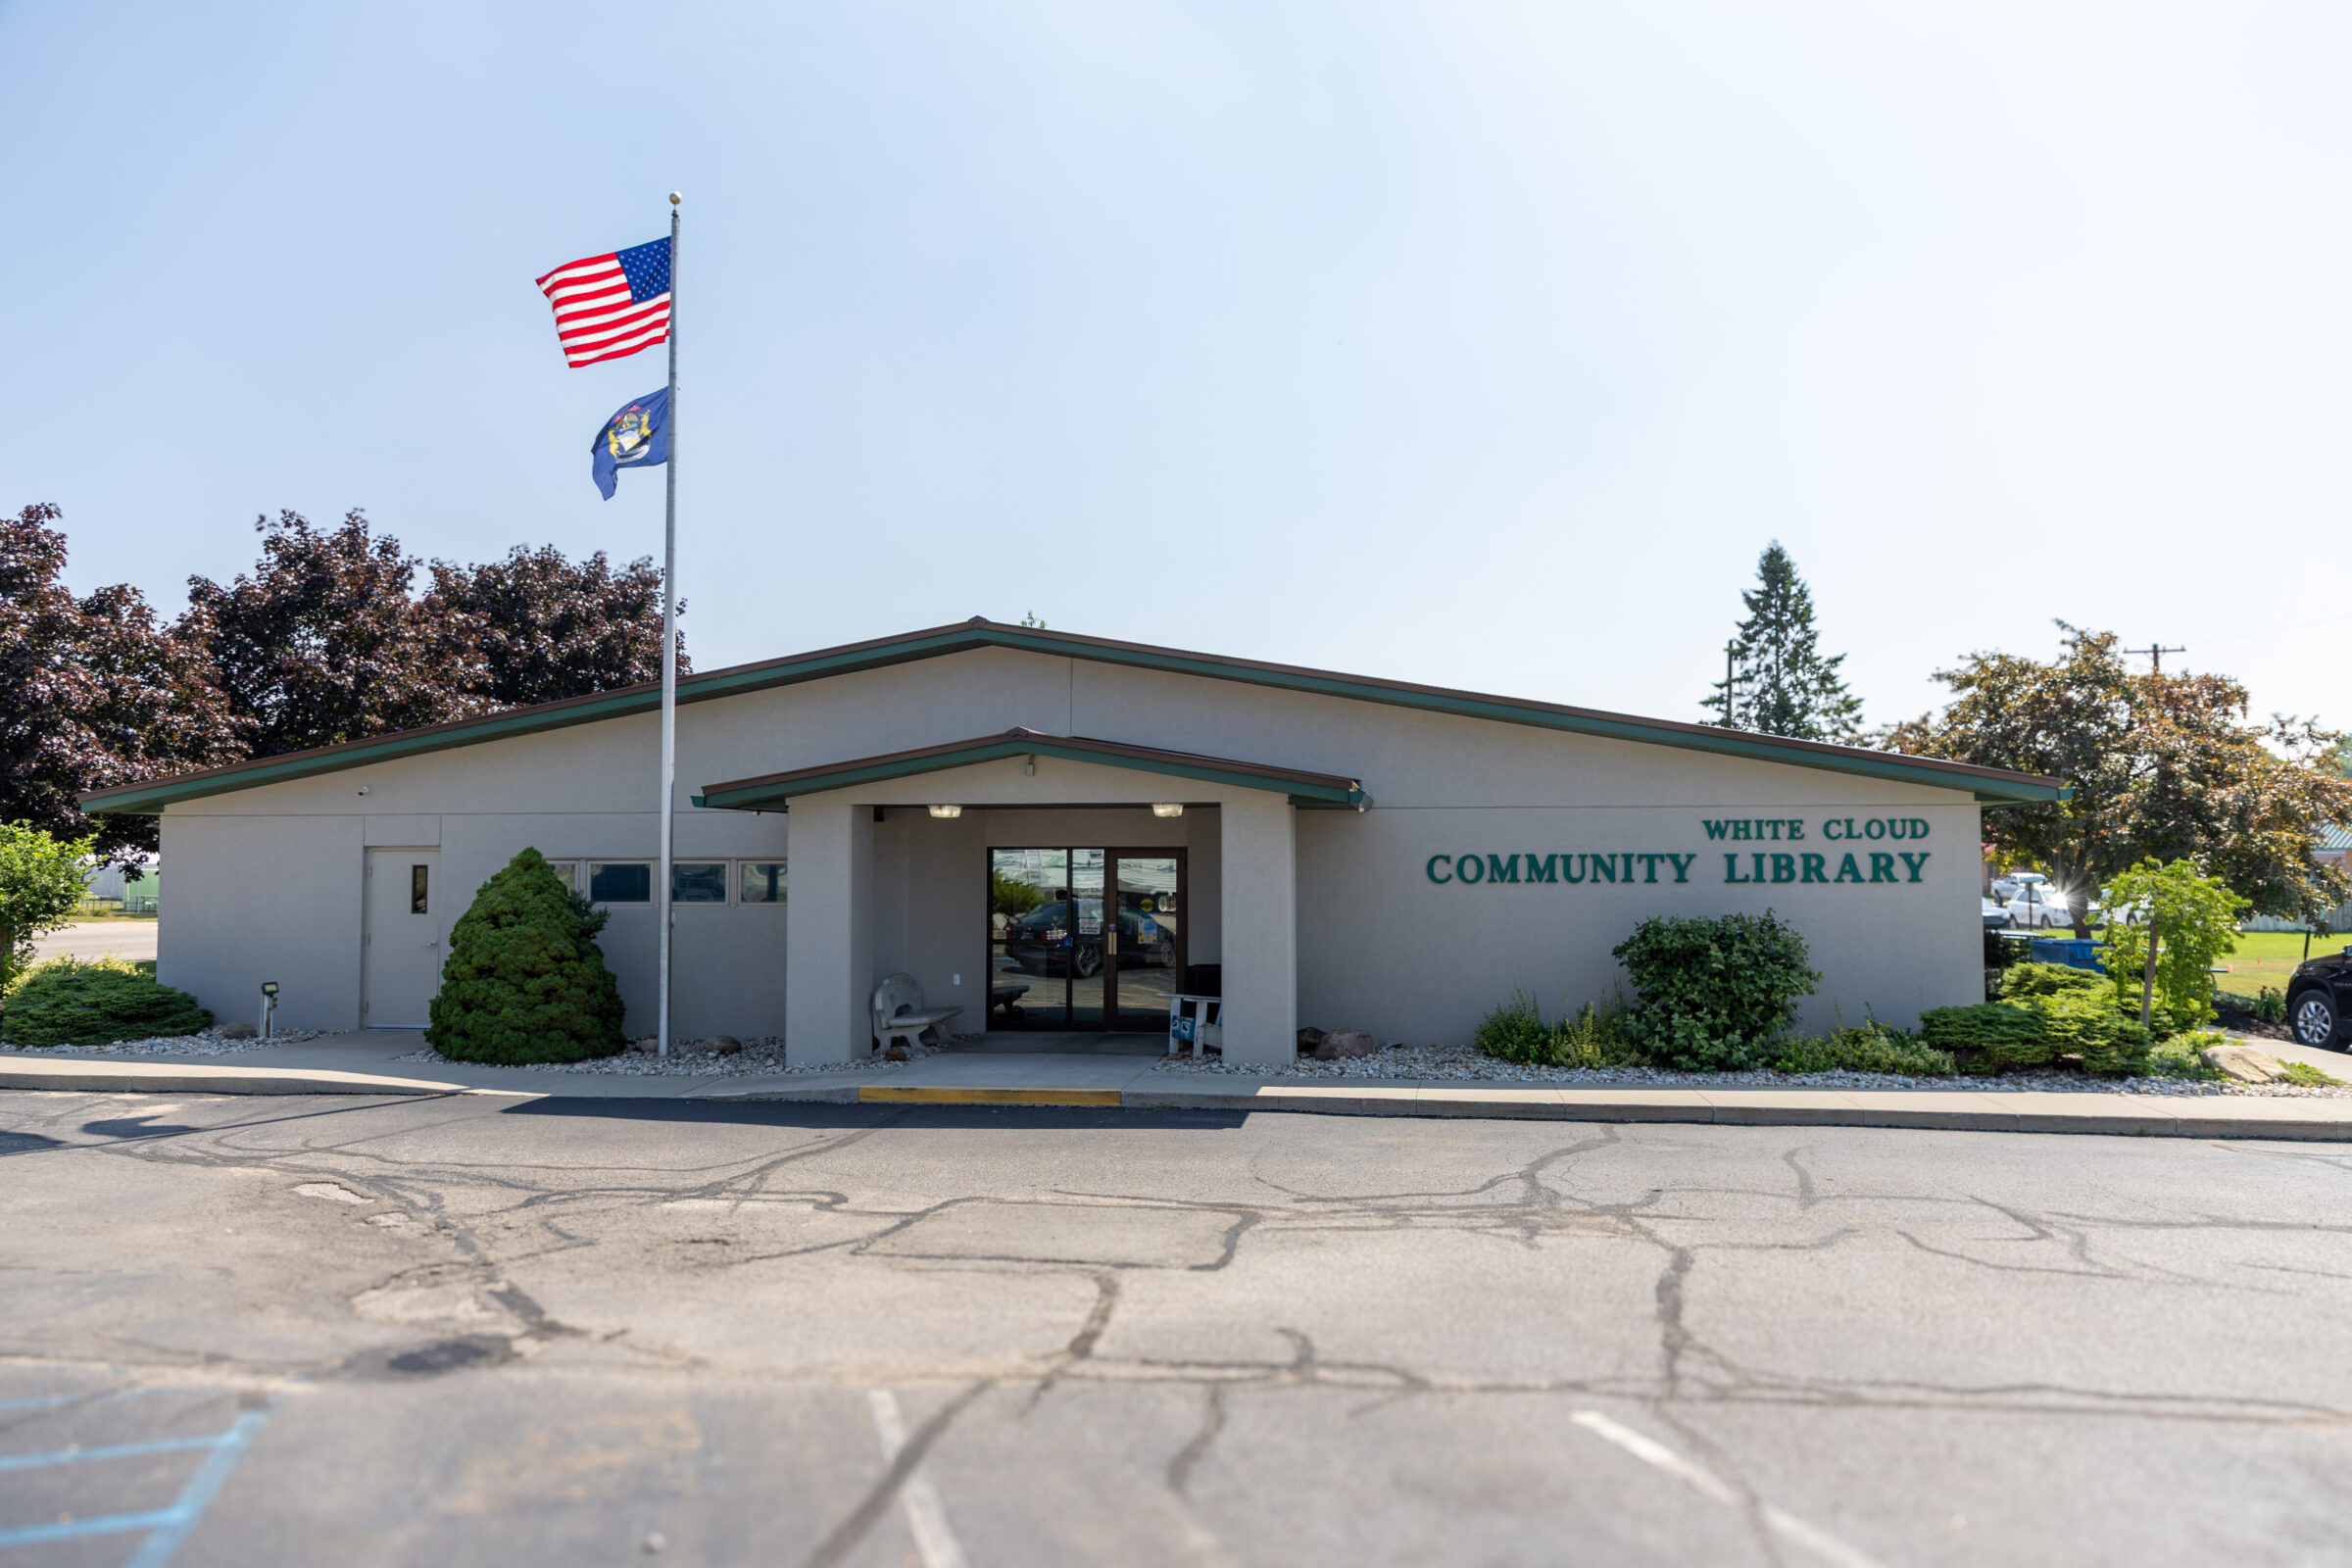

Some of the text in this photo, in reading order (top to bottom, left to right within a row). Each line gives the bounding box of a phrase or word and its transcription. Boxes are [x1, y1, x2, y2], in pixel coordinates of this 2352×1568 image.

[1702, 818, 1930, 841] WHITE CLOUD
[1426, 852, 1931, 884] COMMUNITY LIBRARY
